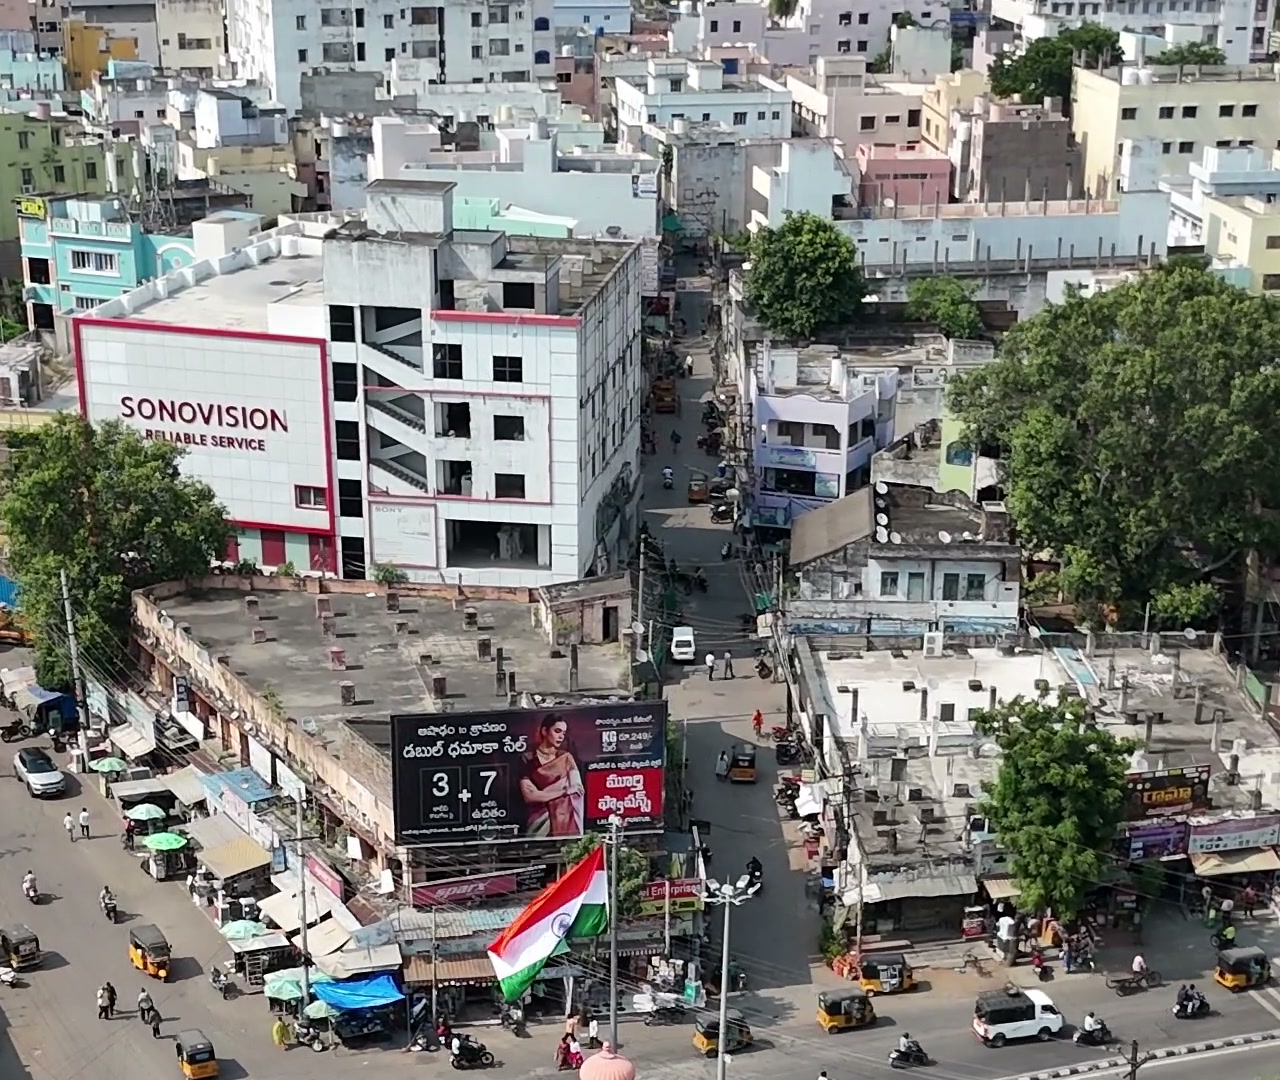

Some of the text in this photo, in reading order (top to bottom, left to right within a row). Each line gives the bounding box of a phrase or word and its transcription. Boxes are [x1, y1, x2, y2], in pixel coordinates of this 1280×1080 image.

[121, 396, 289, 433] SONOVISION
[145, 428, 266, 451] RELIABLE SERVICE
[402, 740, 445, 758] డబుల్
[502, 735, 528, 753] సేల్
[602, 731, 617, 743] KG
[432, 772, 450, 797] 3
[480, 771, 497, 796] 7
[651, 885, 701, 896] Entrprises
